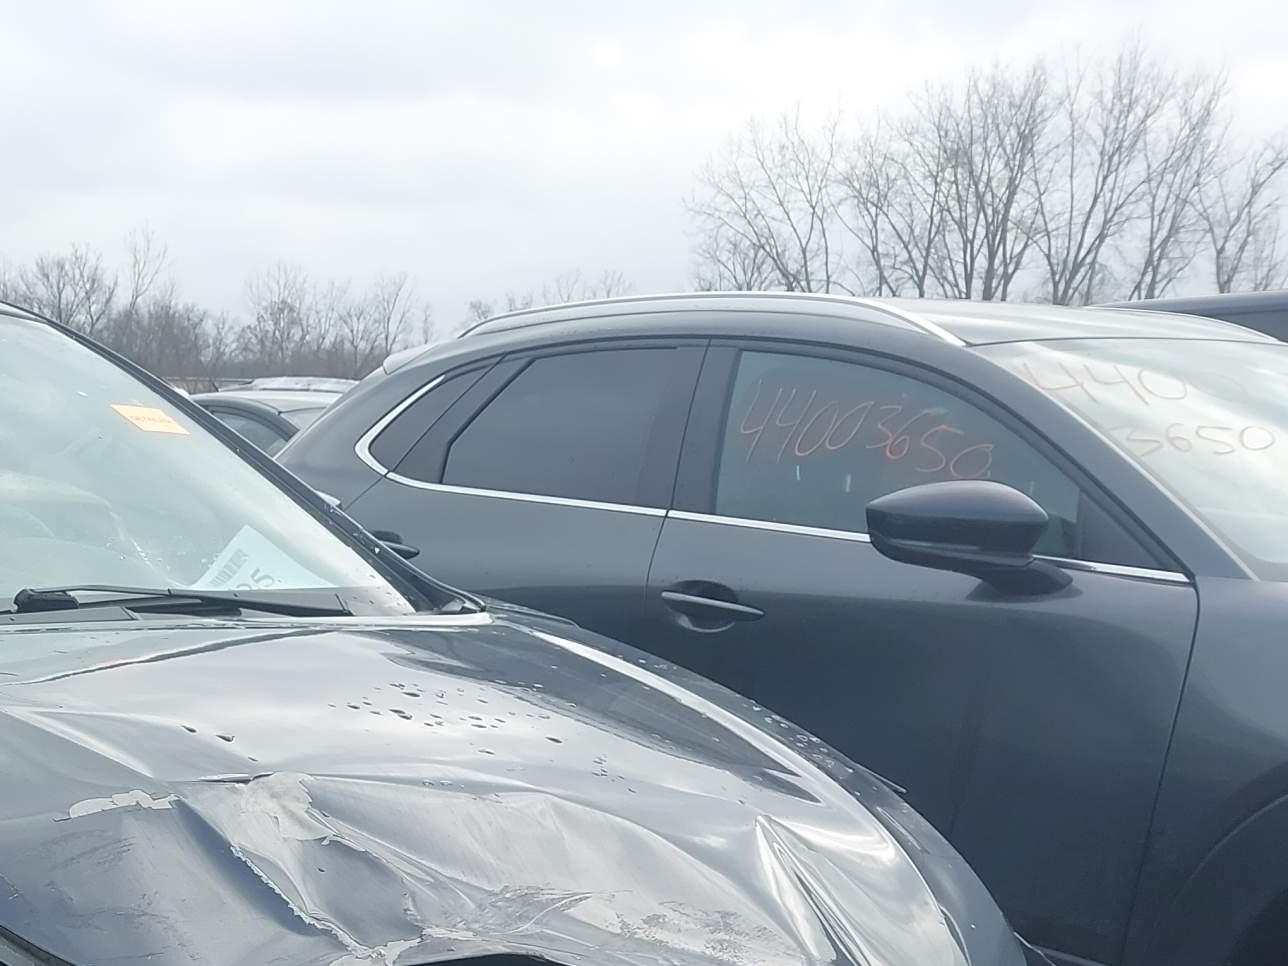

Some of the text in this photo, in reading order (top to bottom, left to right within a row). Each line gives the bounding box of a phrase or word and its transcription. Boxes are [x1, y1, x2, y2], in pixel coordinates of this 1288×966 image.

[1021, 361, 1191, 407] 440
[740, 376, 996, 479] 44003650
[1111, 421, 1276, 456] 3650
